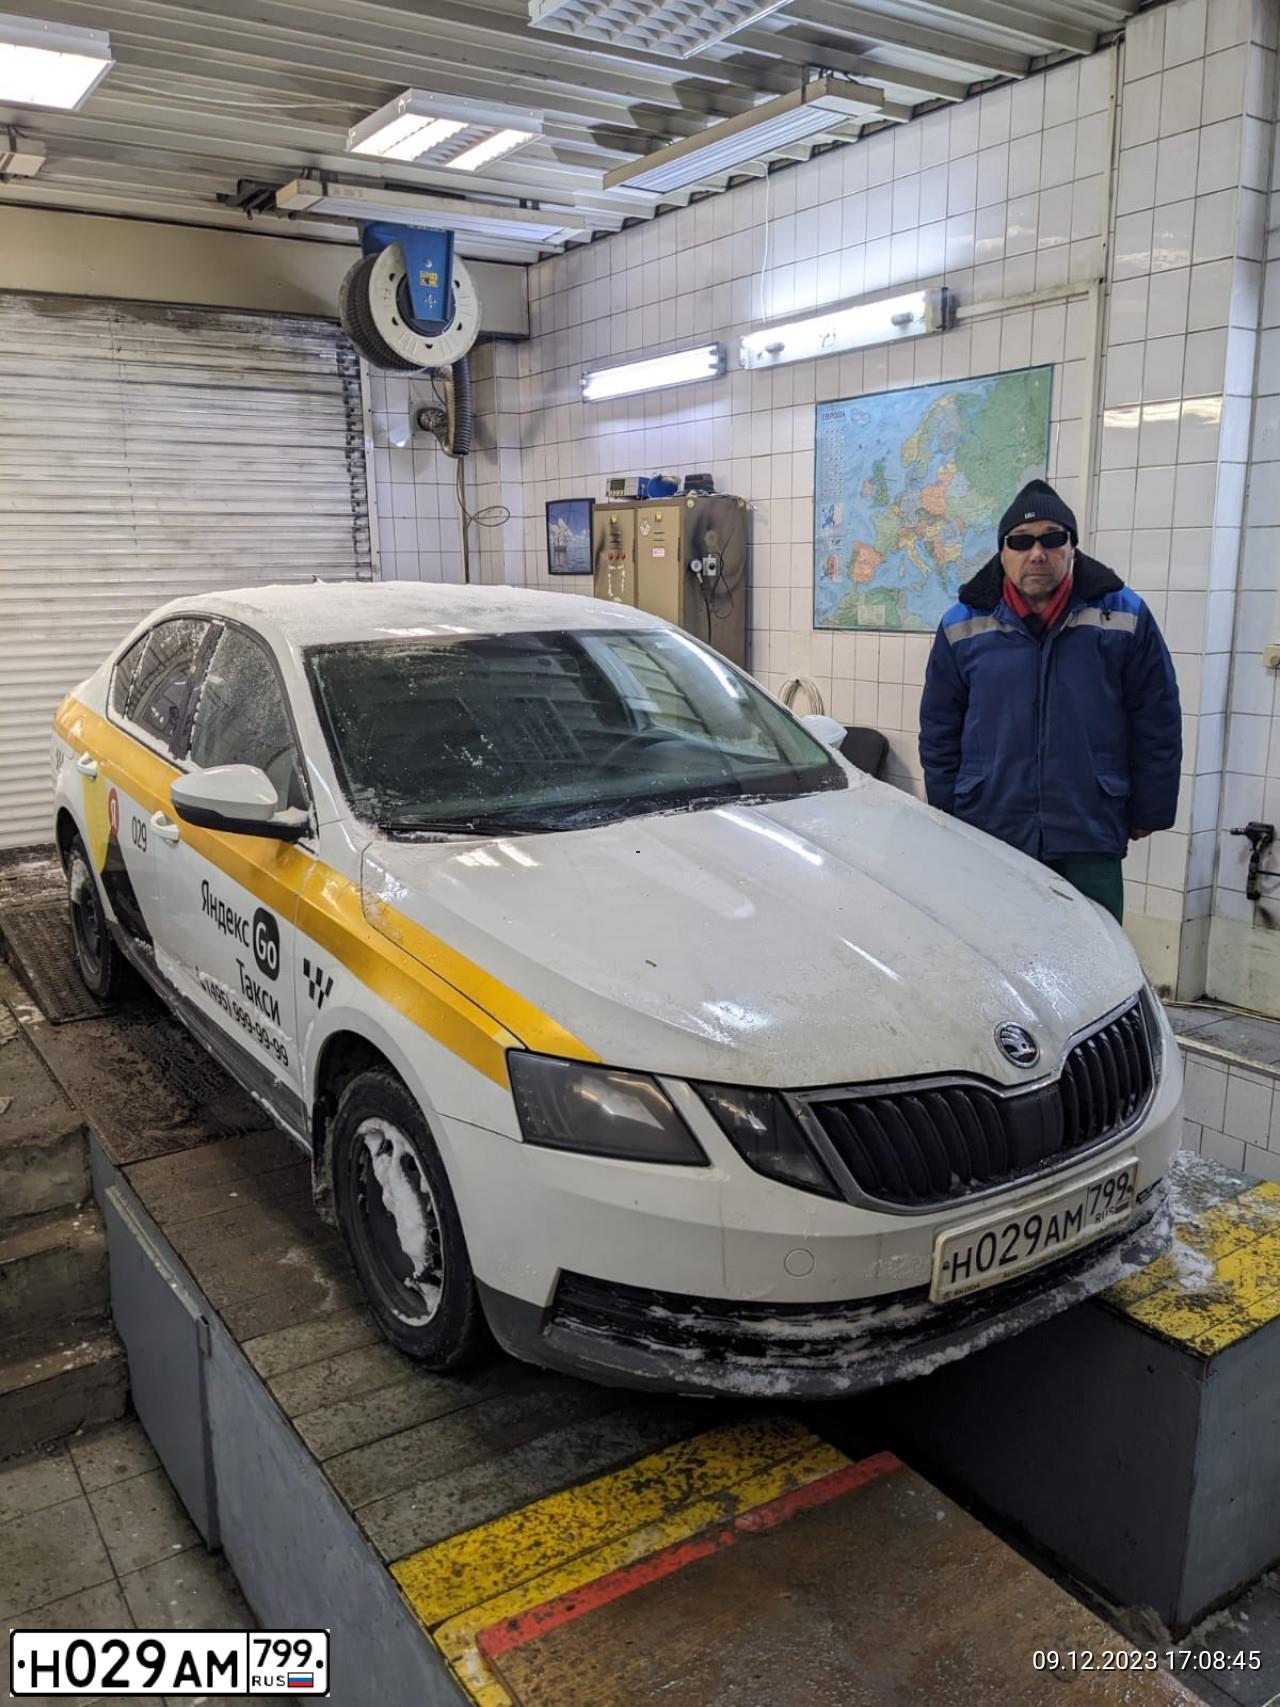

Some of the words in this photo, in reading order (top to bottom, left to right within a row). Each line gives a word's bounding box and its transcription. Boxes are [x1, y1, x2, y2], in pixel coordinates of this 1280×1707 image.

[131, 815, 147, 853] 029
[201, 879, 250, 948] Яндекс
[255, 921, 277, 971] Go
[235, 958, 280, 1026] Такси
[232, 1001, 289, 1068] 999-99-99
[1090, 1172, 1129, 1216] 799
